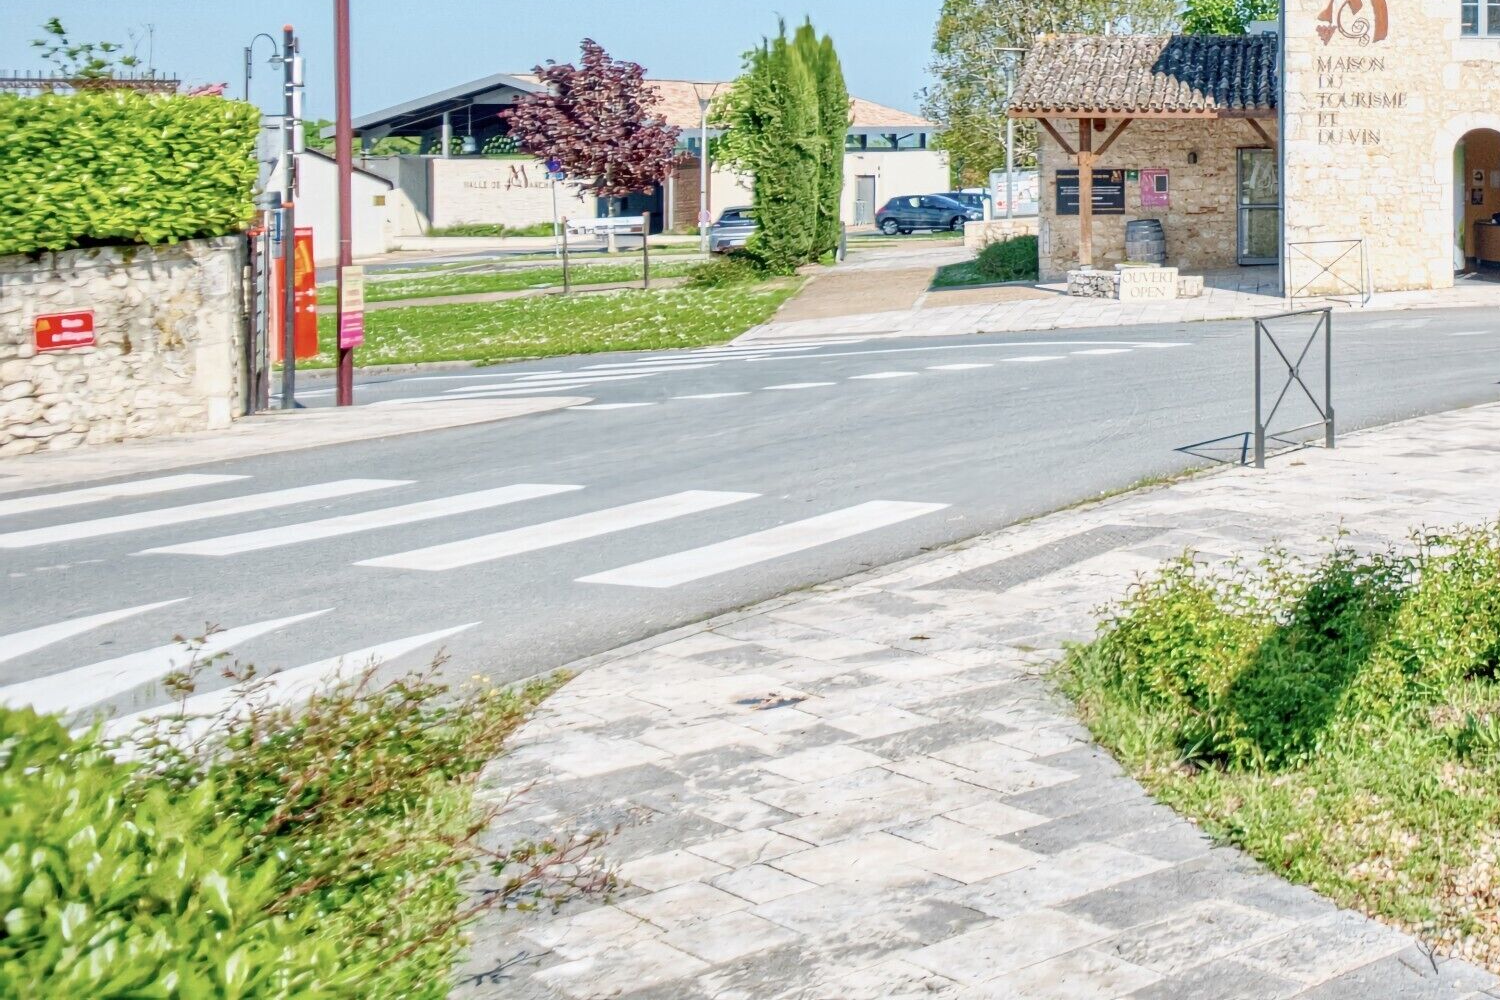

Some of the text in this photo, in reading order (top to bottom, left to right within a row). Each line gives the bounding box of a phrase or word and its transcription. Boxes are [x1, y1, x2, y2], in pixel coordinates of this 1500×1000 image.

[1317, 56, 1385, 73] MAISON
[1318, 74, 1343, 89] DU
[1316, 92, 1407, 109] TOURISME
[1318, 111, 1340, 127] ET
[1318, 129, 1381, 145] DU VIN
[1123, 272, 1174, 283] OUVERT
[1131, 286, 1164, 298] OPEN
